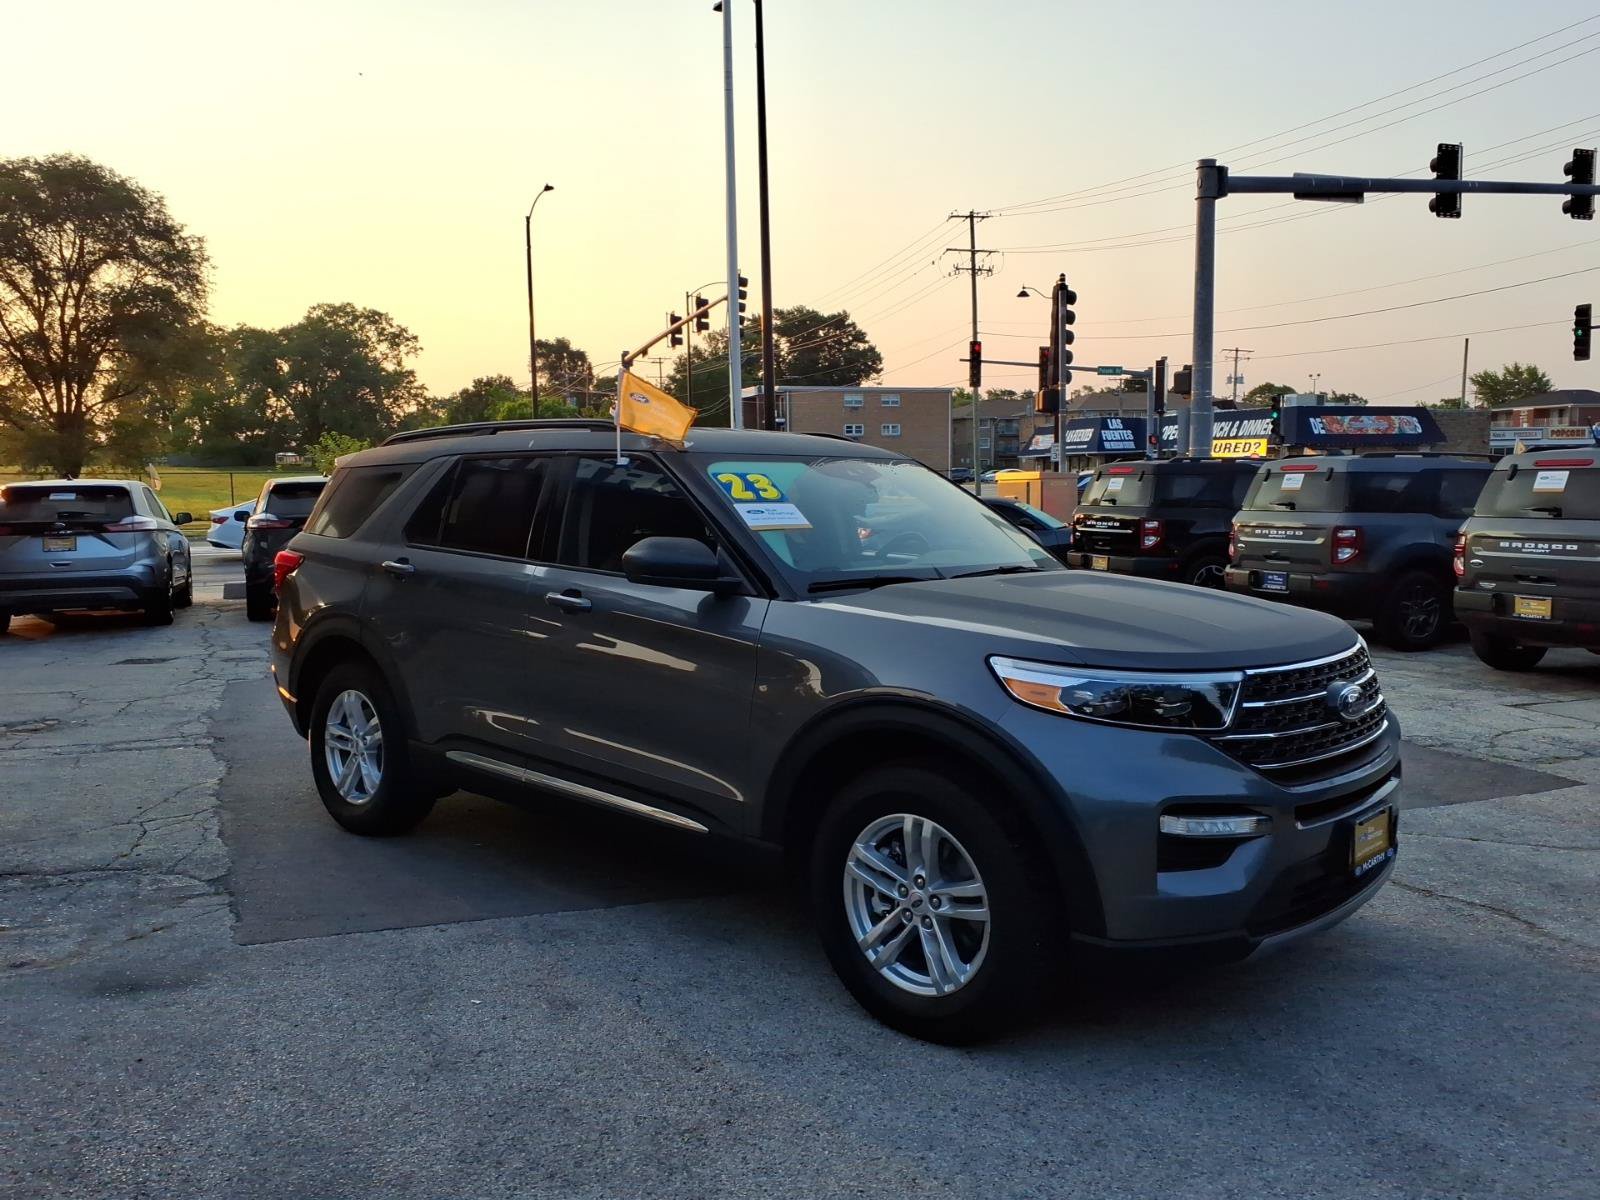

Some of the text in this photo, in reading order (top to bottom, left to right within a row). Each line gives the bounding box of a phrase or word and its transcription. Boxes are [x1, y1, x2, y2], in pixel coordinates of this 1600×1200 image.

[1107, 419, 1124, 430] LAS
[1101, 430, 1135, 441] FUENTES
[717, 473, 781, 500] 23
[1500, 541, 1578, 551] BRONCO
